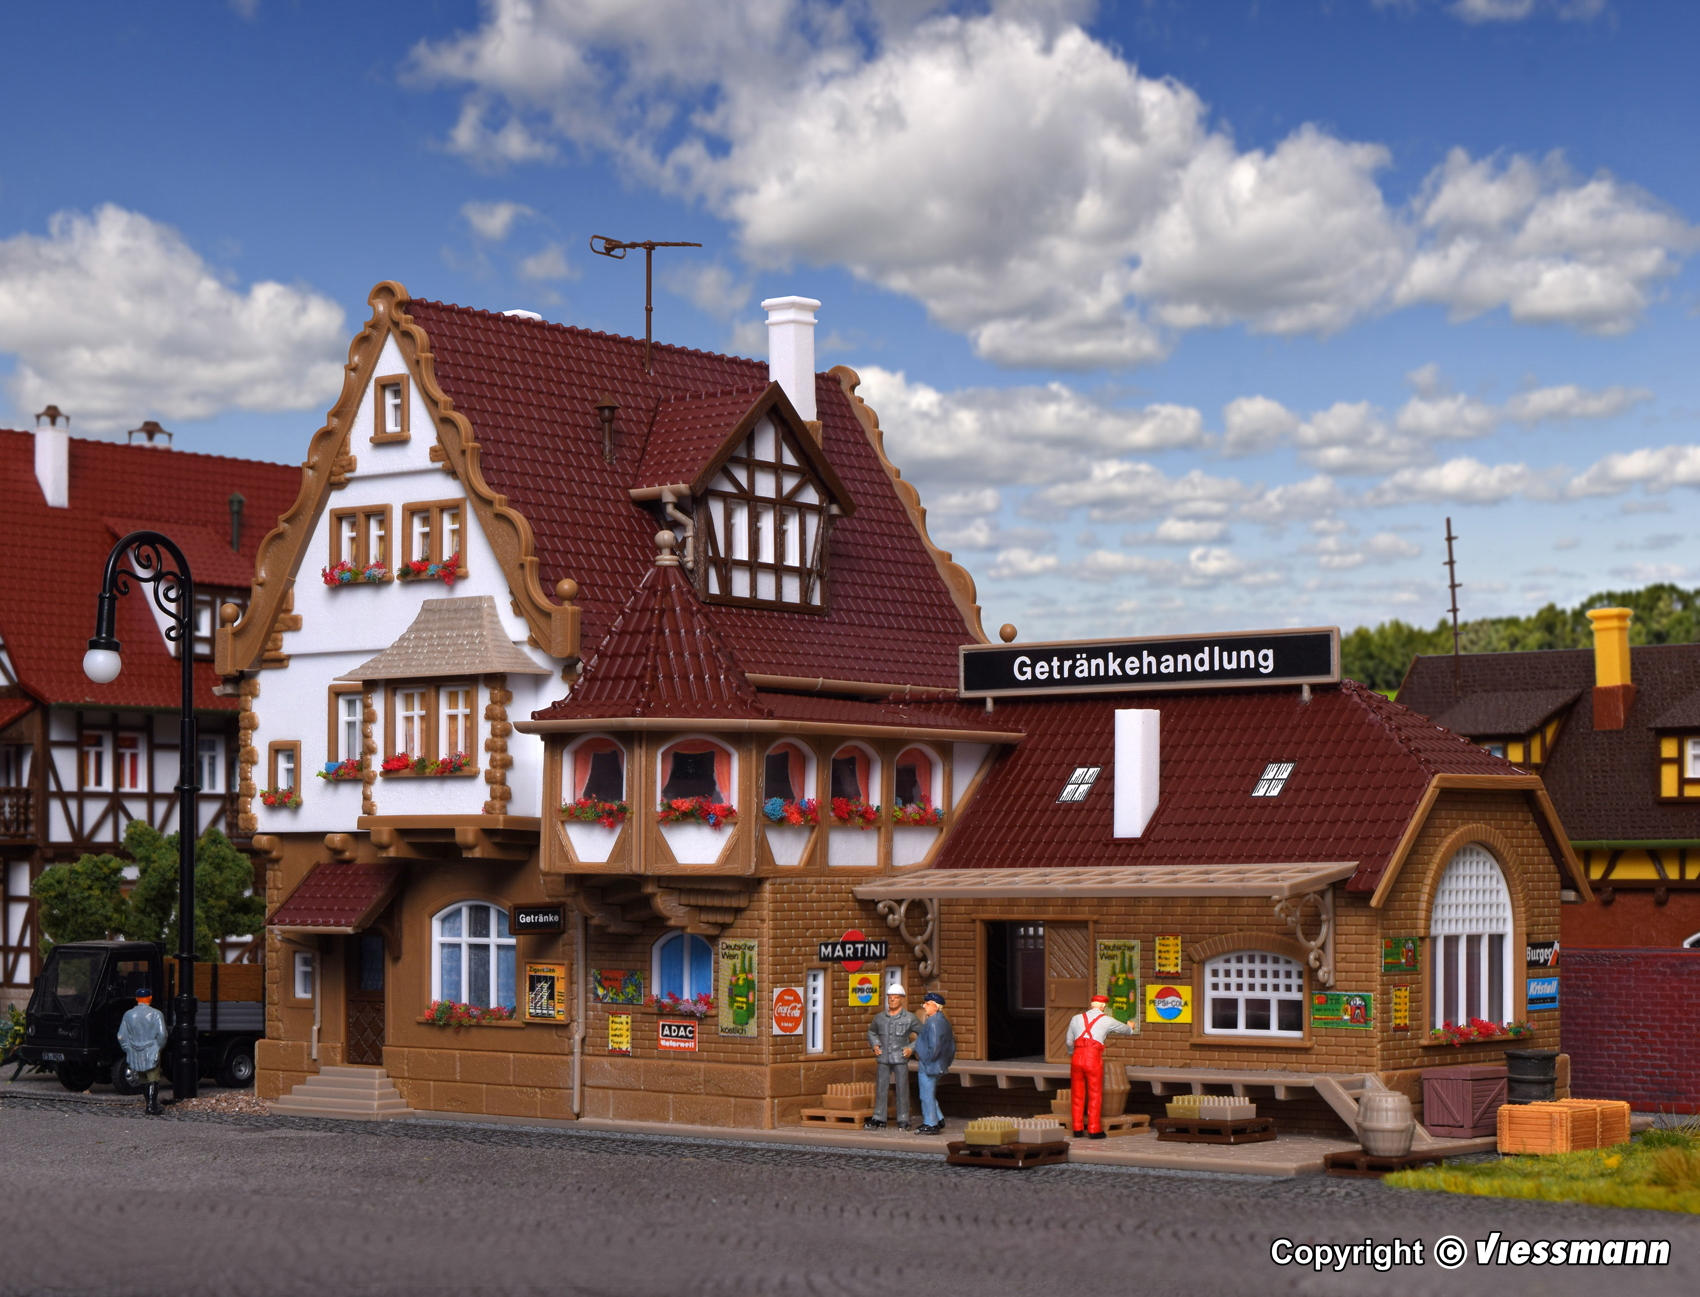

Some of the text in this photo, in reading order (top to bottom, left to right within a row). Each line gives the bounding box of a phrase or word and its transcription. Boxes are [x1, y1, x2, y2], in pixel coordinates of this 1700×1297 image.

[1013, 646, 1275, 681] Getränkehandlung
[519, 913, 560, 924] Getränke
[721, 942, 756, 952] Deutscher
[820, 943, 886, 958] MARTINI
[1099, 943, 1136, 952] Deutscher
[721, 952, 739, 960] Wein
[1099, 952, 1118, 961] Wein
[851, 986, 878, 994] PEPSI-COLA
[1529, 980, 1557, 996] Kristall
[1148, 999, 1189, 1008] PEPSI-COLA
[662, 1025, 695, 1038] ADAC
